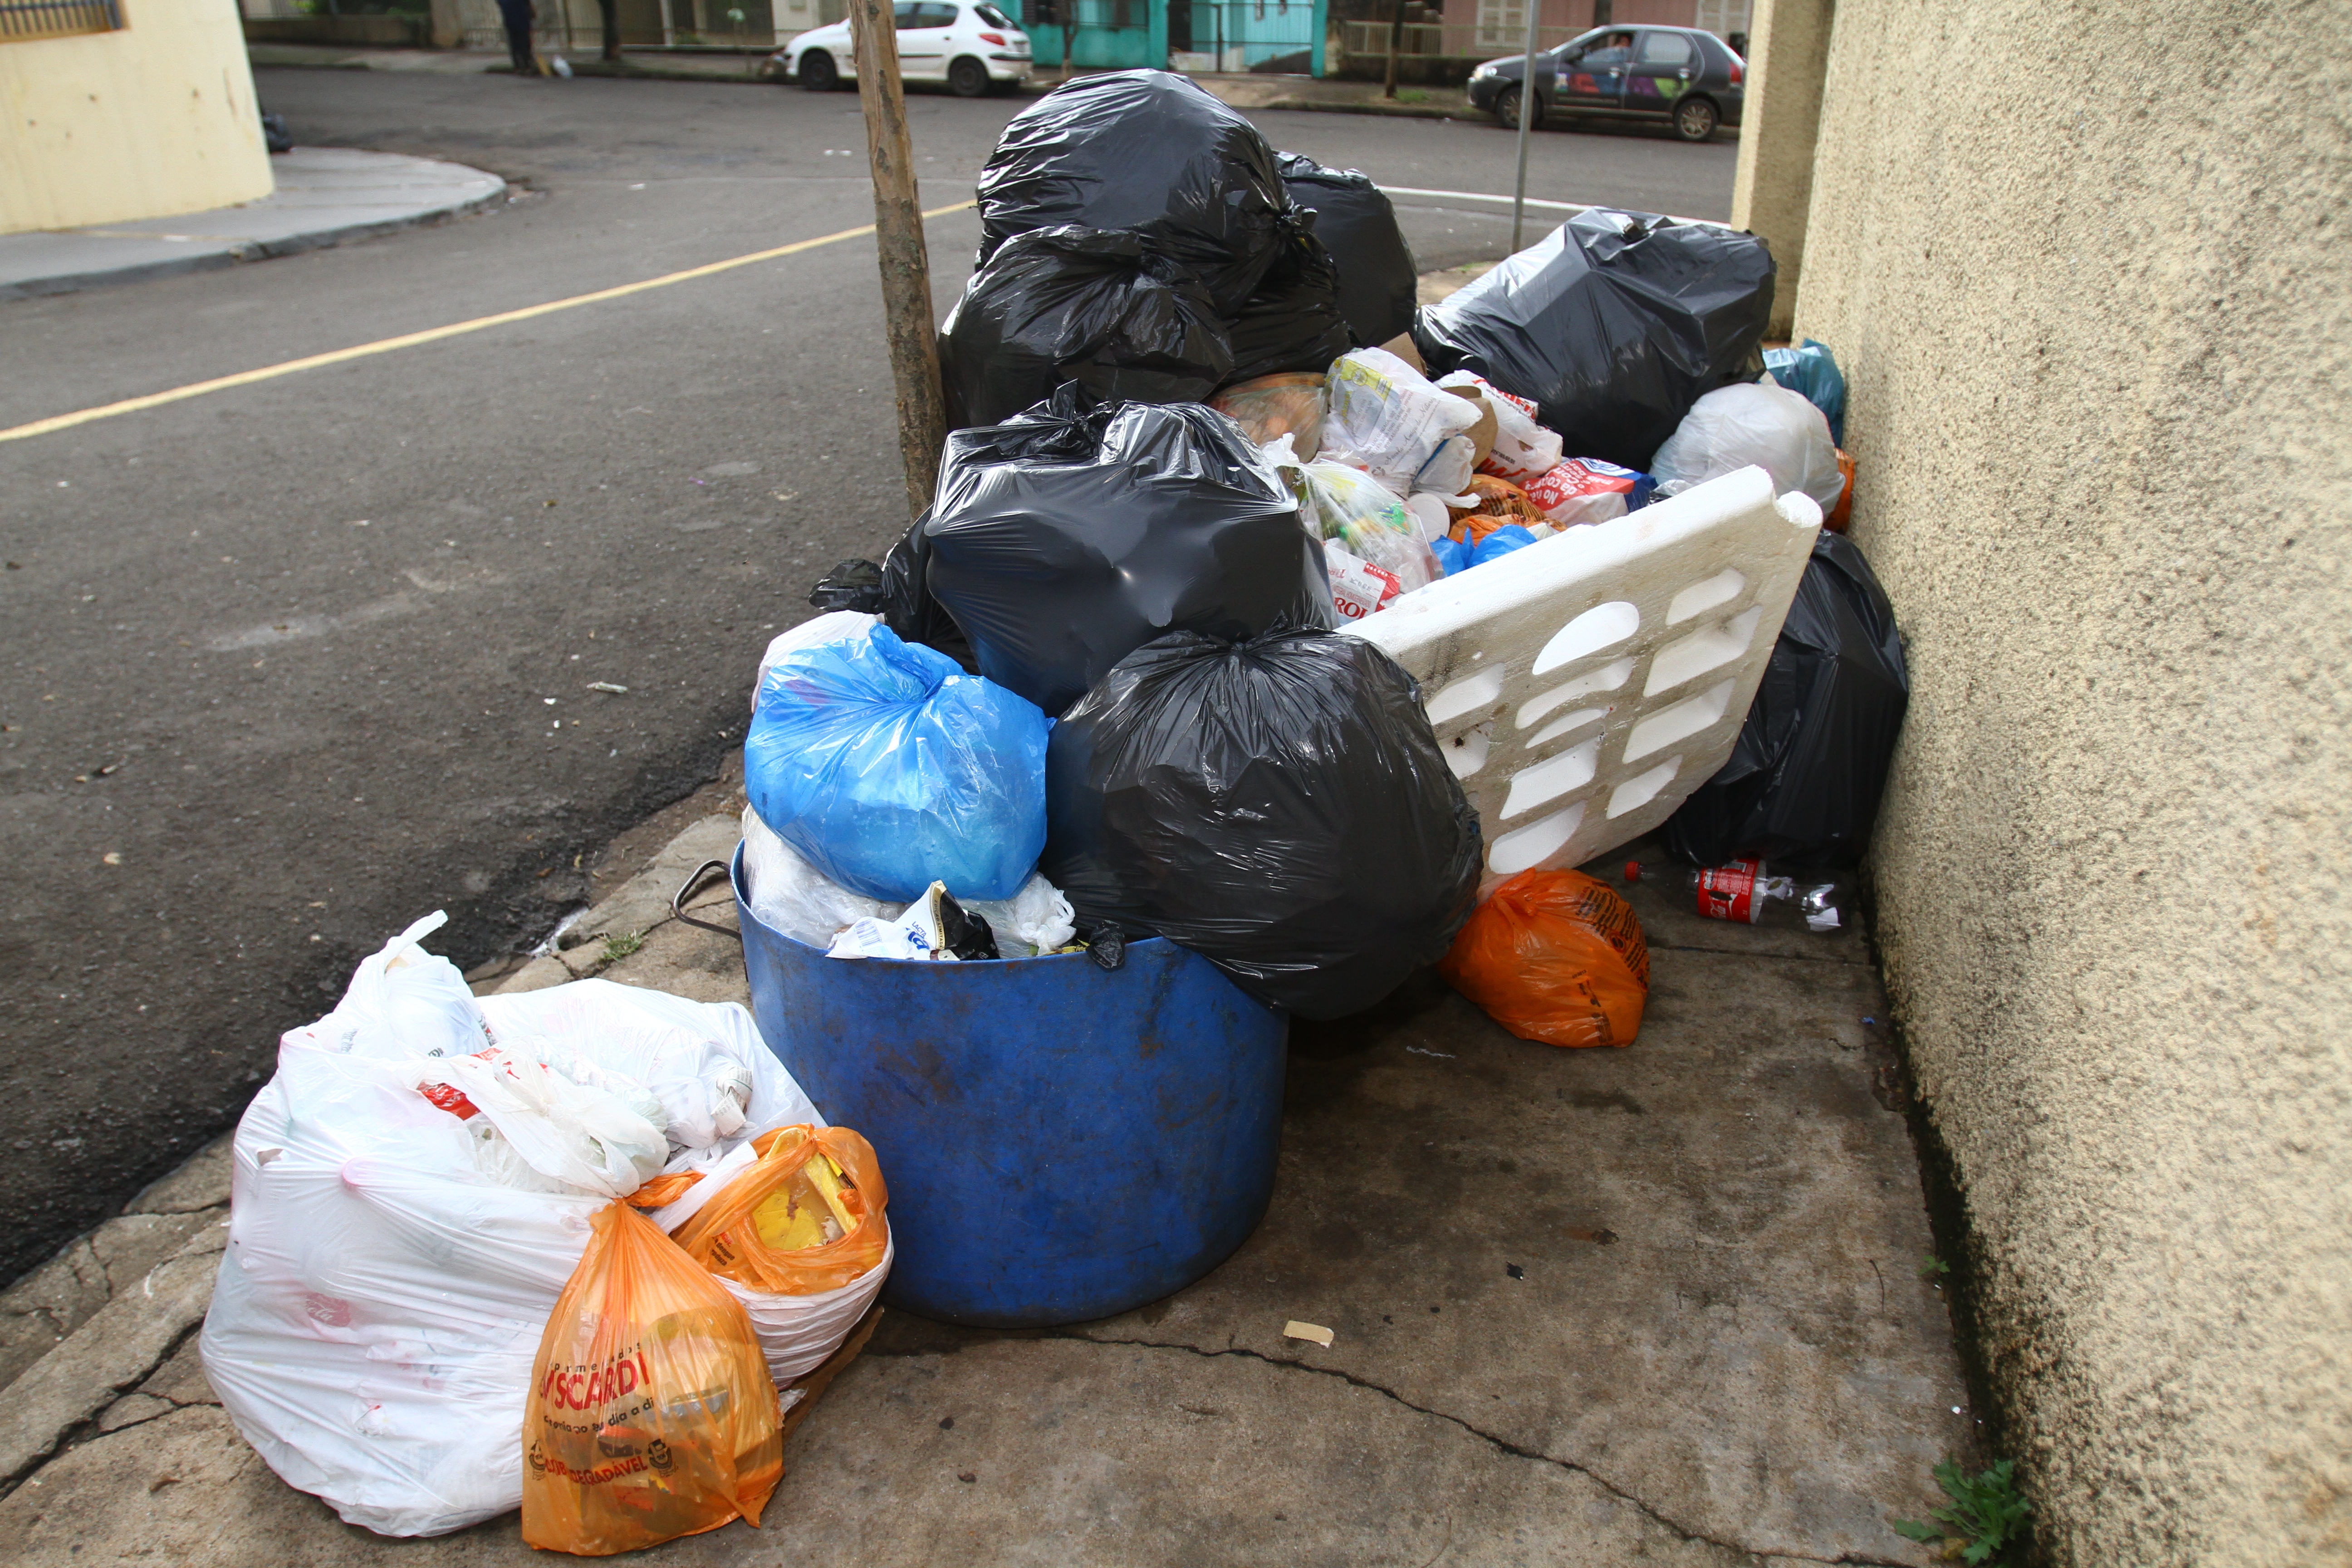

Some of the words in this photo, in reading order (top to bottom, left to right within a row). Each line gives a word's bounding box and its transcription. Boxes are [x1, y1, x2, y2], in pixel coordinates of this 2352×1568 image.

[911, 921, 927, 936] LACTA
[711, 1249, 727, 1266] roduza
[716, 1242, 735, 1260] dengue
[608, 1411, 627, 1427] dia
[631, 1406, 639, 1416] a
[642, 1397, 654, 1411] di
